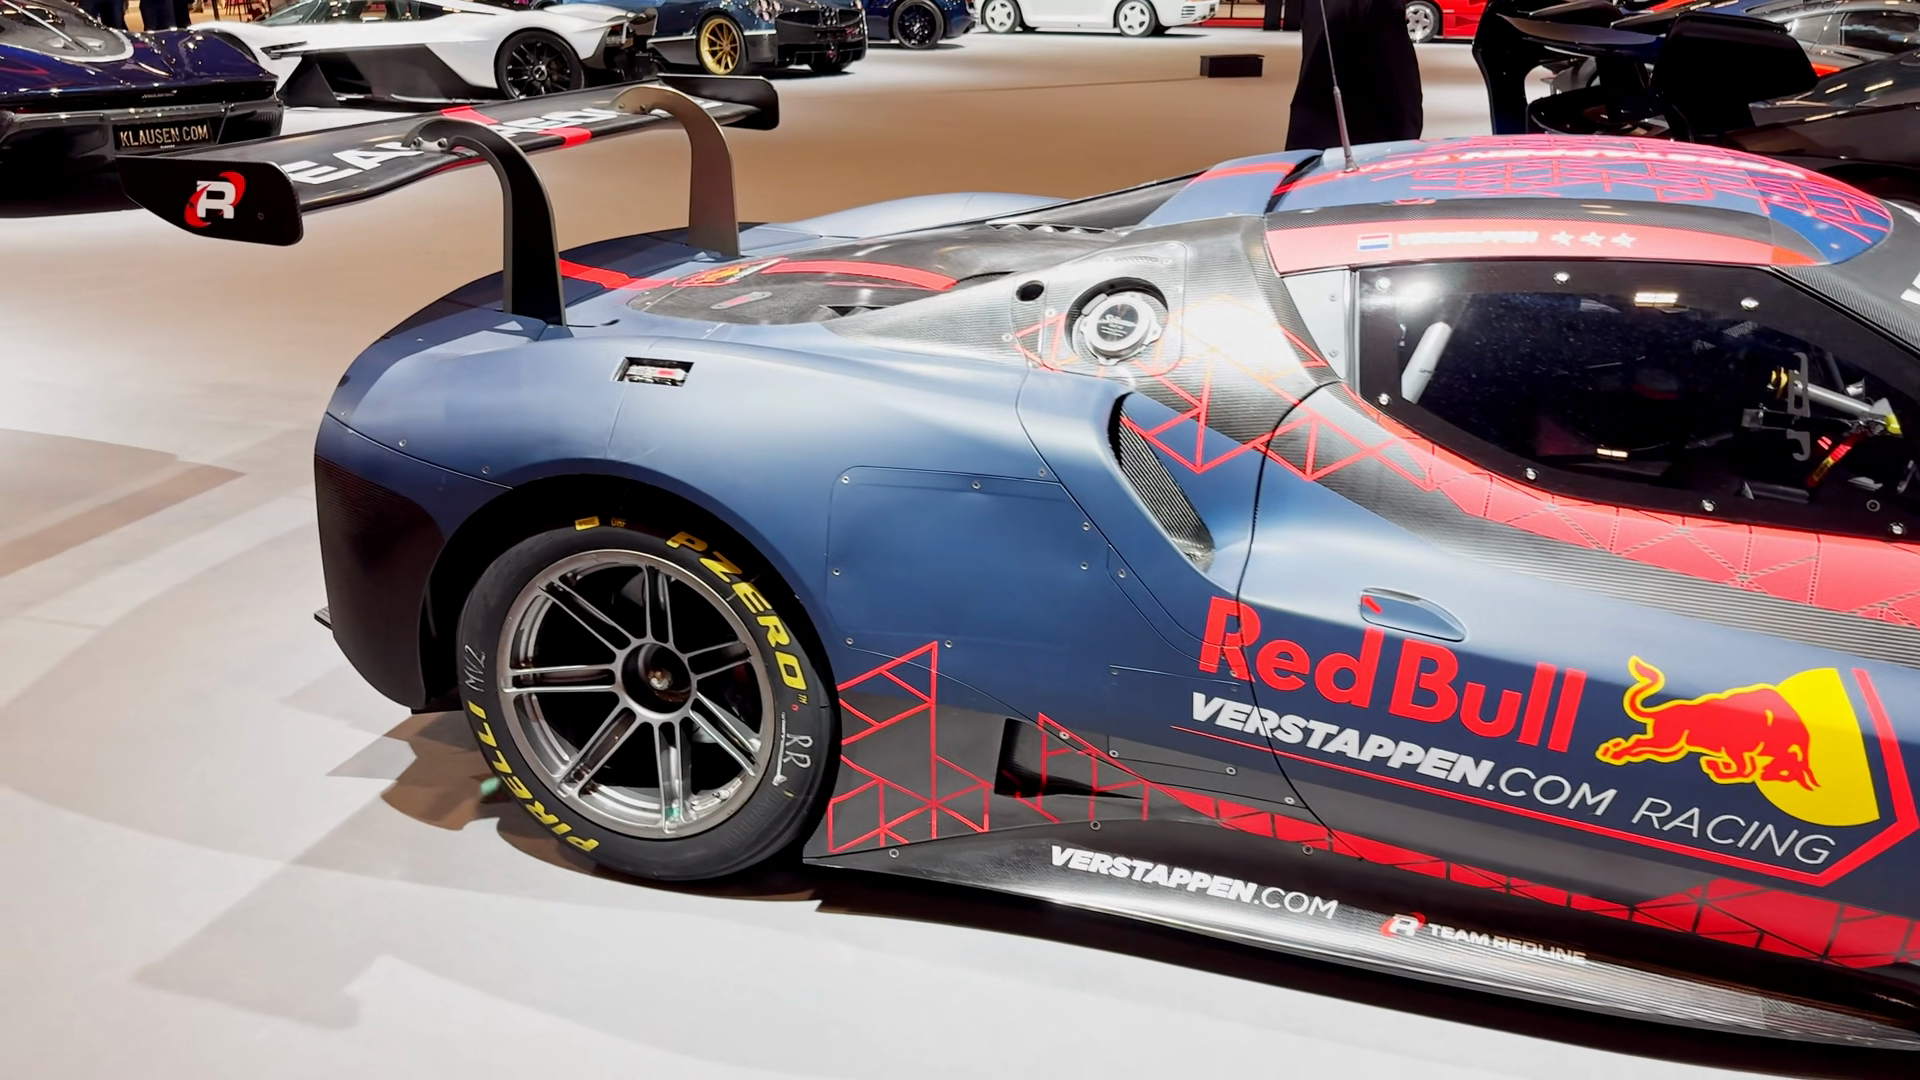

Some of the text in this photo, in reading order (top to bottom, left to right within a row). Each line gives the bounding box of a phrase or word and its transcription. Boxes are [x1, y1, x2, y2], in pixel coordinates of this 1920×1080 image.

[120, 124, 209, 147] KLAUSEN COM
[196, 181, 236, 219] R
[1198, 596, 1588, 753] Red Bull
[467, 700, 600, 852] PIRELLI
[783, 733, 813, 768] RR
[1192, 691, 1836, 865] VERSTAPPEN.COM RACING
[1051, 845, 1338, 919] VERSTAPPEN.COM
[1427, 922, 1490, 947] TEAM
[1492, 934, 1587, 965] REDLINE
